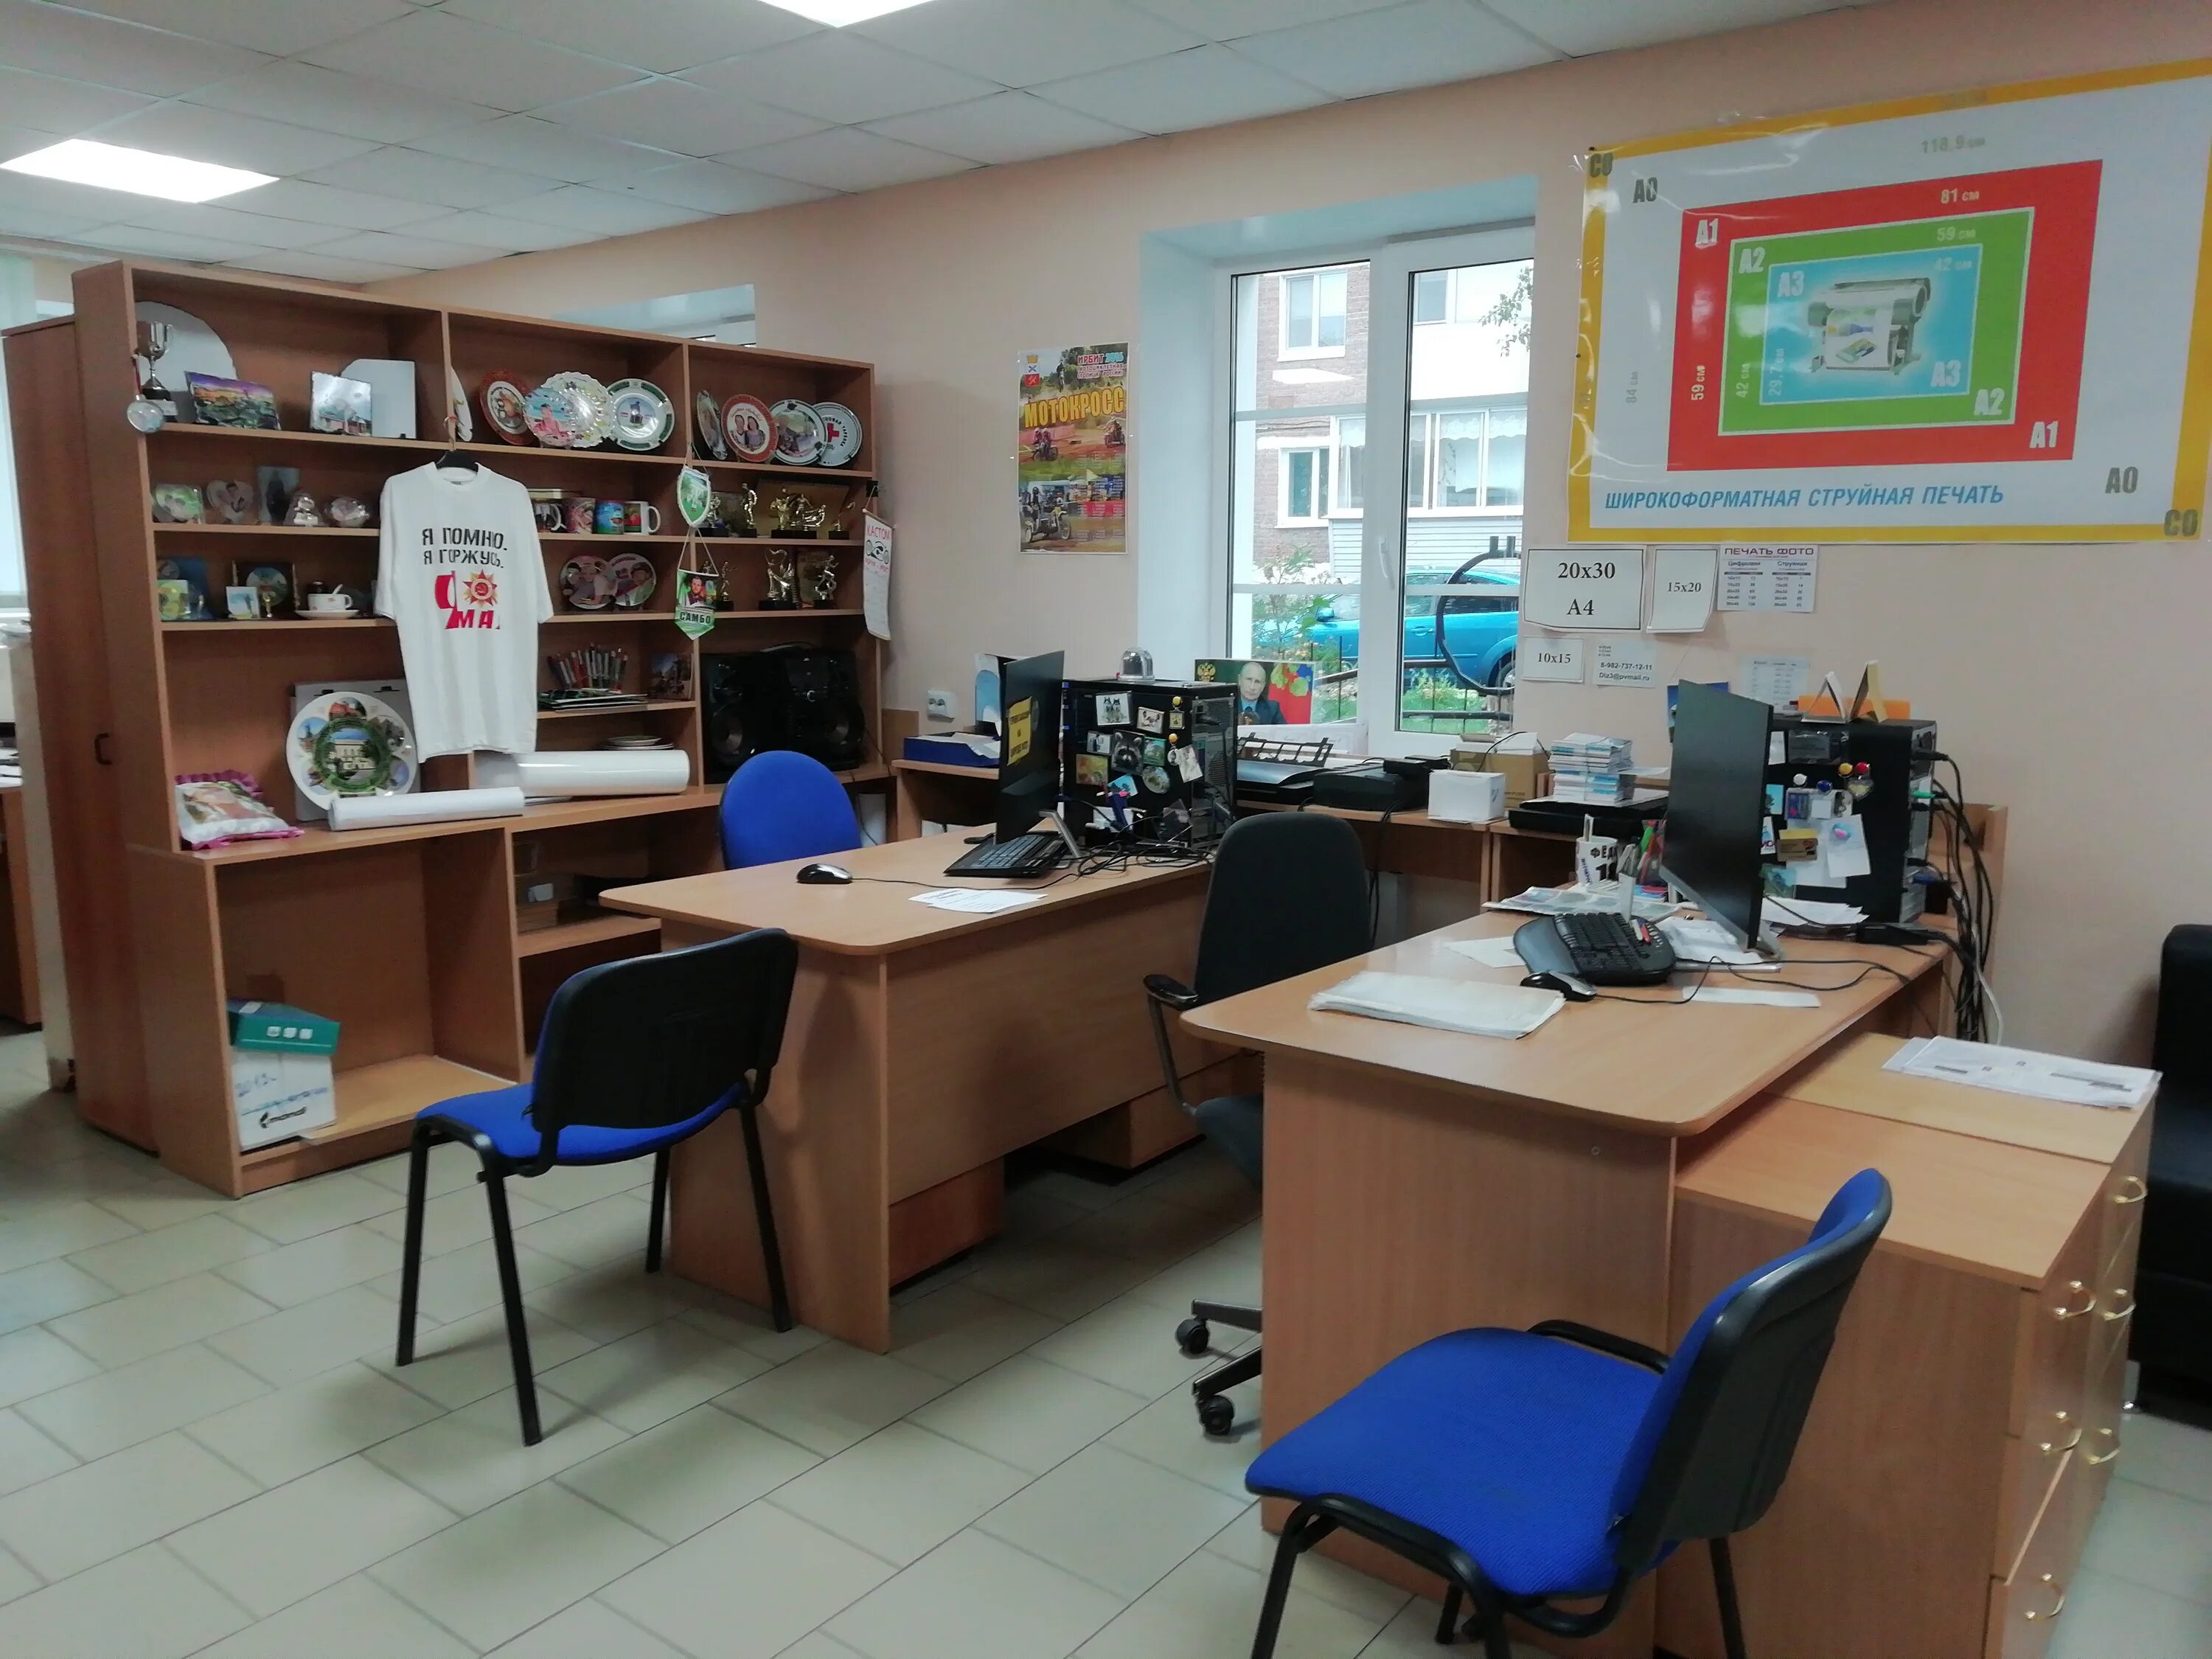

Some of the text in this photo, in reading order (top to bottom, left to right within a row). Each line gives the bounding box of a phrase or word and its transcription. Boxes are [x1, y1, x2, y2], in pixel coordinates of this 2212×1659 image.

[1941, 188, 1958, 204] 81
[1694, 218, 1719, 246] A1
[1936, 226, 1955, 242] 59
[1739, 246, 1765, 274] A2
[1777, 270, 1804, 298] A3
[1077, 353, 1104, 364] ИРБИТ
[1930, 360, 1961, 387] A3
[1691, 384, 1705, 400] 59
[1736, 381, 1749, 398] 42
[1024, 386, 1124, 428] МОТОКРОСС
[1973, 388, 2006, 416] A2
[2029, 420, 2058, 448] A1
[1605, 484, 2004, 509] ШИРОКОФОРМАТНАЯ СТРУЙНАЯ ПЕЧАТЬ
[422, 528, 434, 546] Я
[424, 549, 432, 565] Я
[1557, 562, 1615, 579] 20x30
[1667, 582, 1702, 593] 15x20
[1566, 598, 1594, 616] A4
[456, 609, 501, 630] МА
[680, 611, 711, 625] САМБО
[1537, 653, 1571, 664] 10x15
